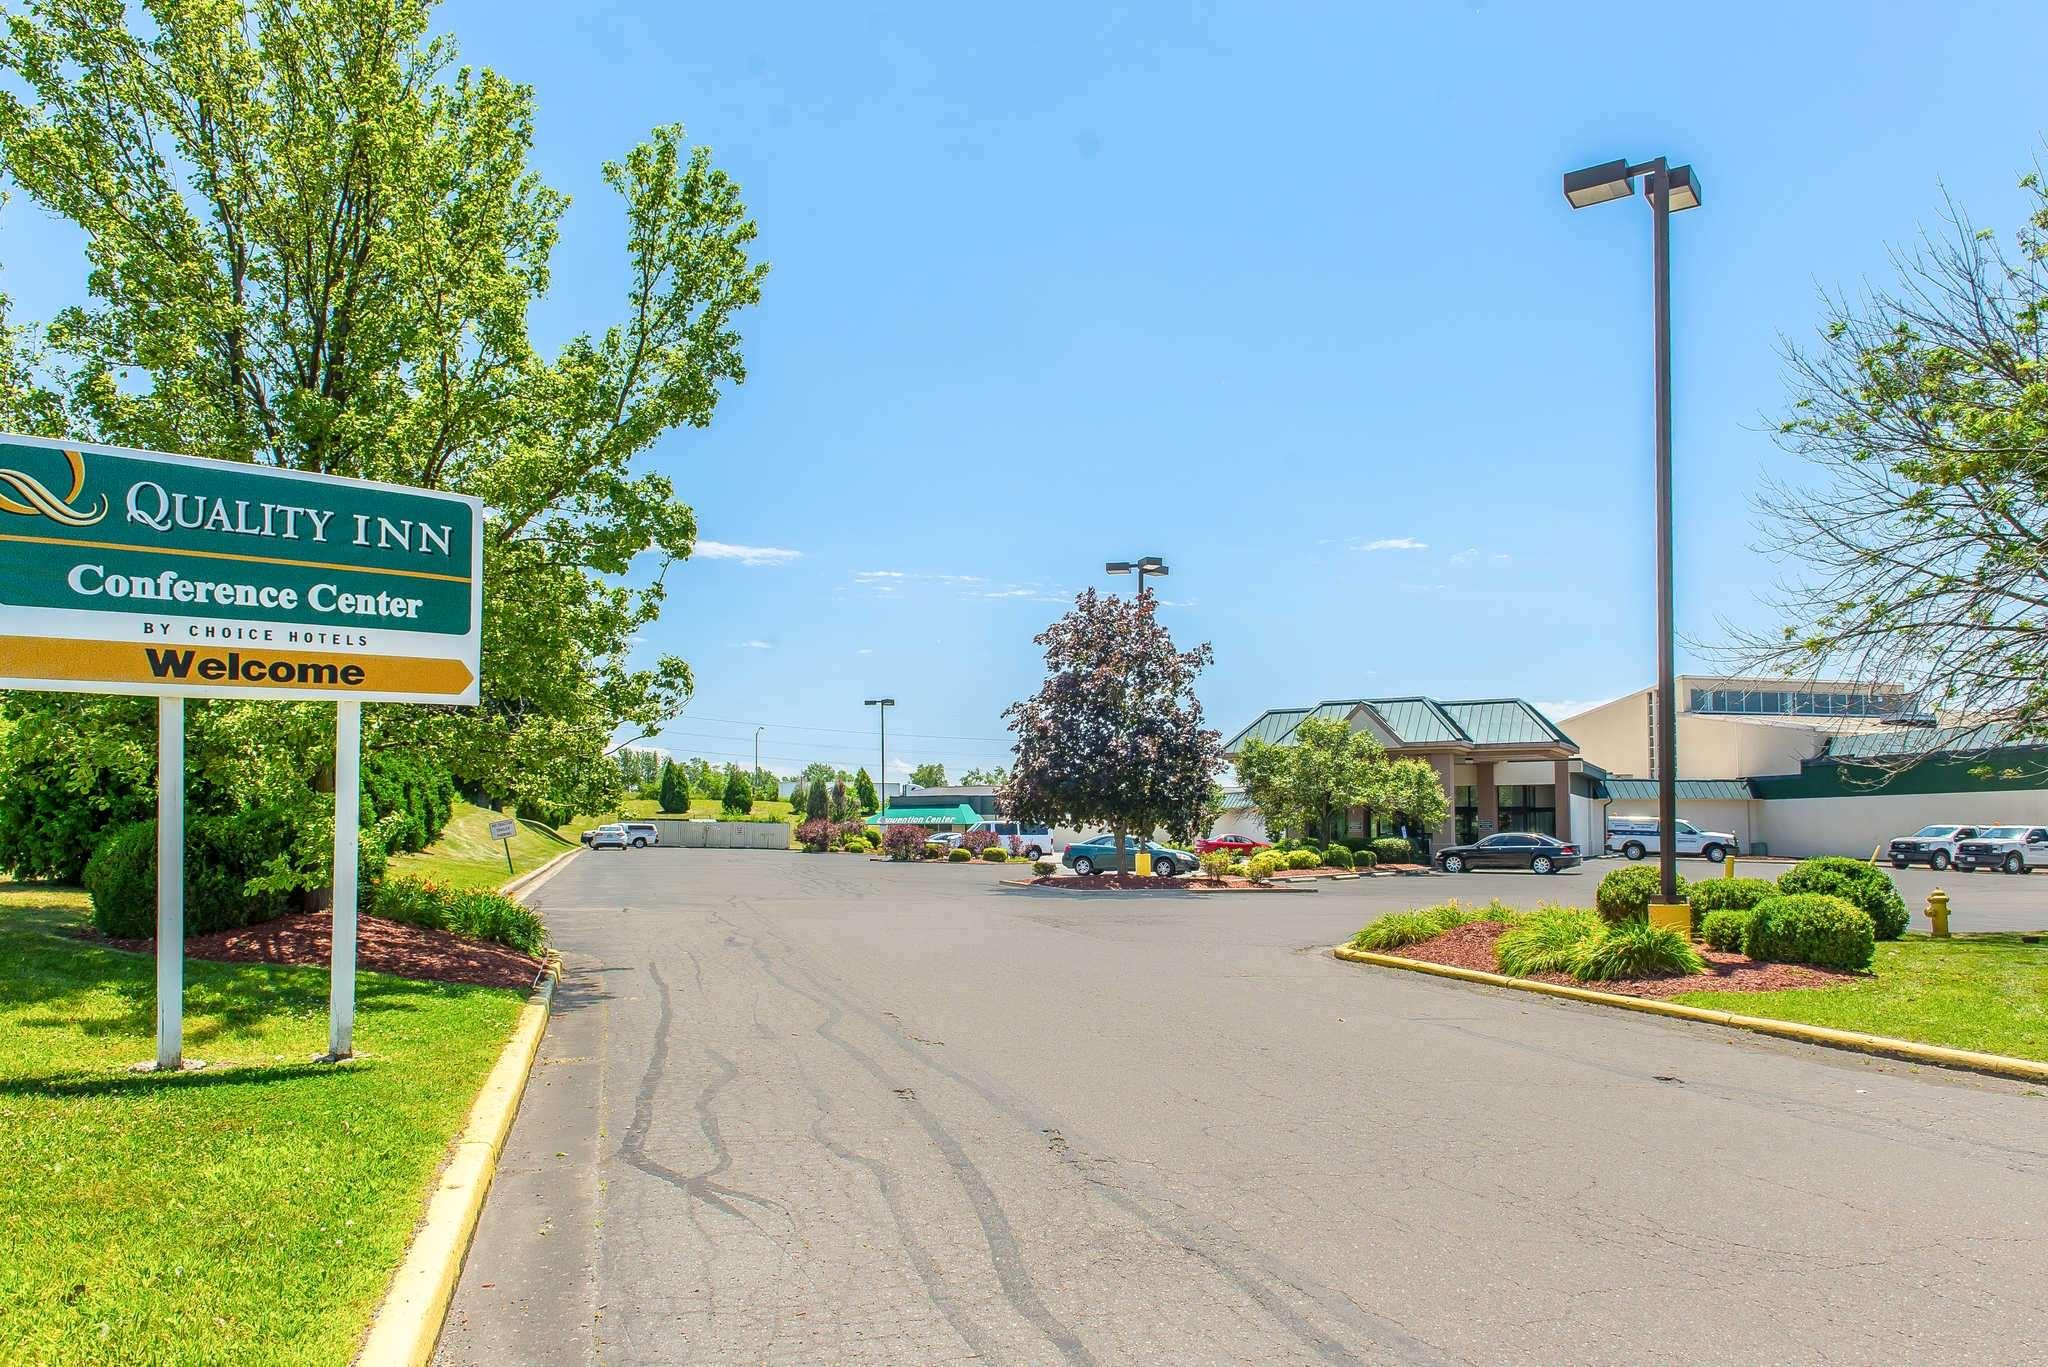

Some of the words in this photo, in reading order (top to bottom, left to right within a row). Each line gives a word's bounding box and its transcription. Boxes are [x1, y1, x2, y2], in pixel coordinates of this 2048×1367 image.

[126, 480, 334, 542] QUALITY
[352, 513, 453, 557] INN
[67, 563, 298, 609] Conference
[307, 583, 423, 618] Center
[143, 622, 171, 636] BY
[189, 625, 274, 641] CHOICE
[289, 631, 368, 646] HOTELS
[145, 648, 366, 685] Welcome
[925, 815, 955, 824] Center
